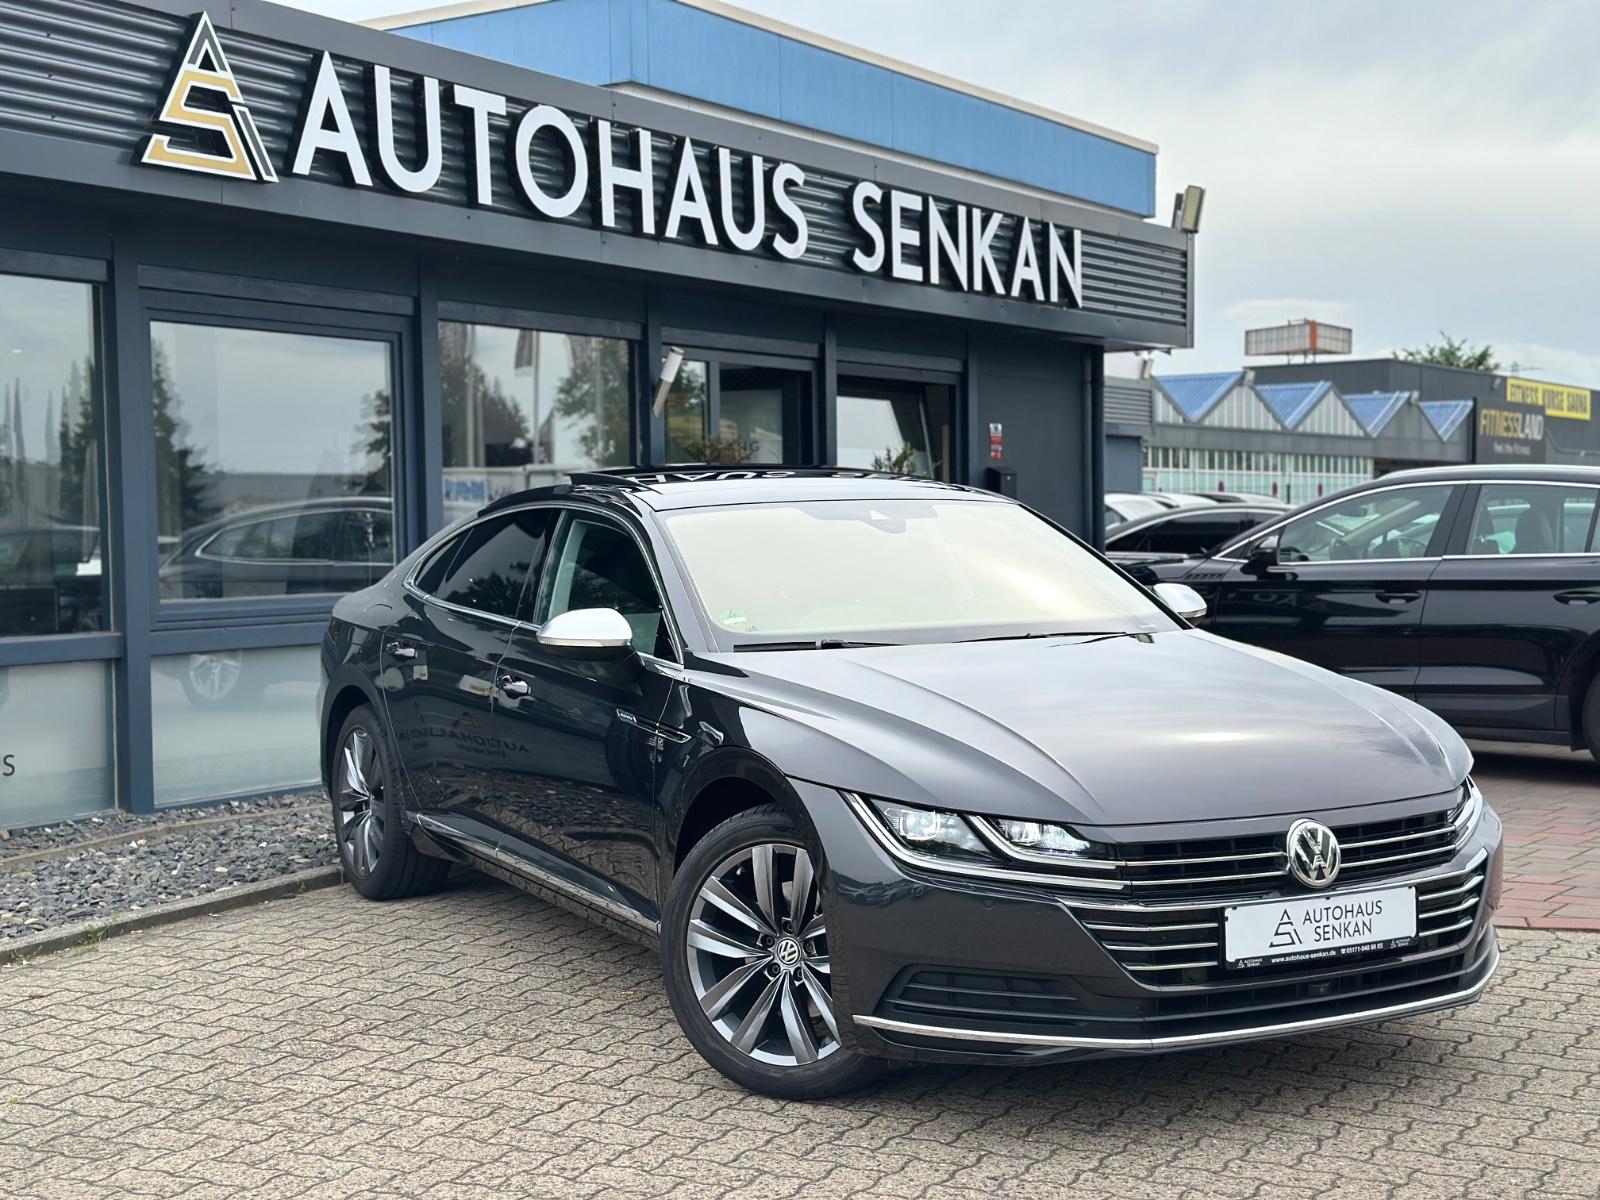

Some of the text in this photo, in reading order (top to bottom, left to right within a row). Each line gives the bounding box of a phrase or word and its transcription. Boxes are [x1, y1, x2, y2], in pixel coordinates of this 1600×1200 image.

[293, 50, 1083, 308] AUTOHAUS SENKAN
[2, 754, 16, 777] S
[1303, 901, 1382, 924] AUTOHAUS
[1314, 919, 1372, 942] SENKAN
[1271, 950, 1336, 963] www.autohaus-senkan.de
